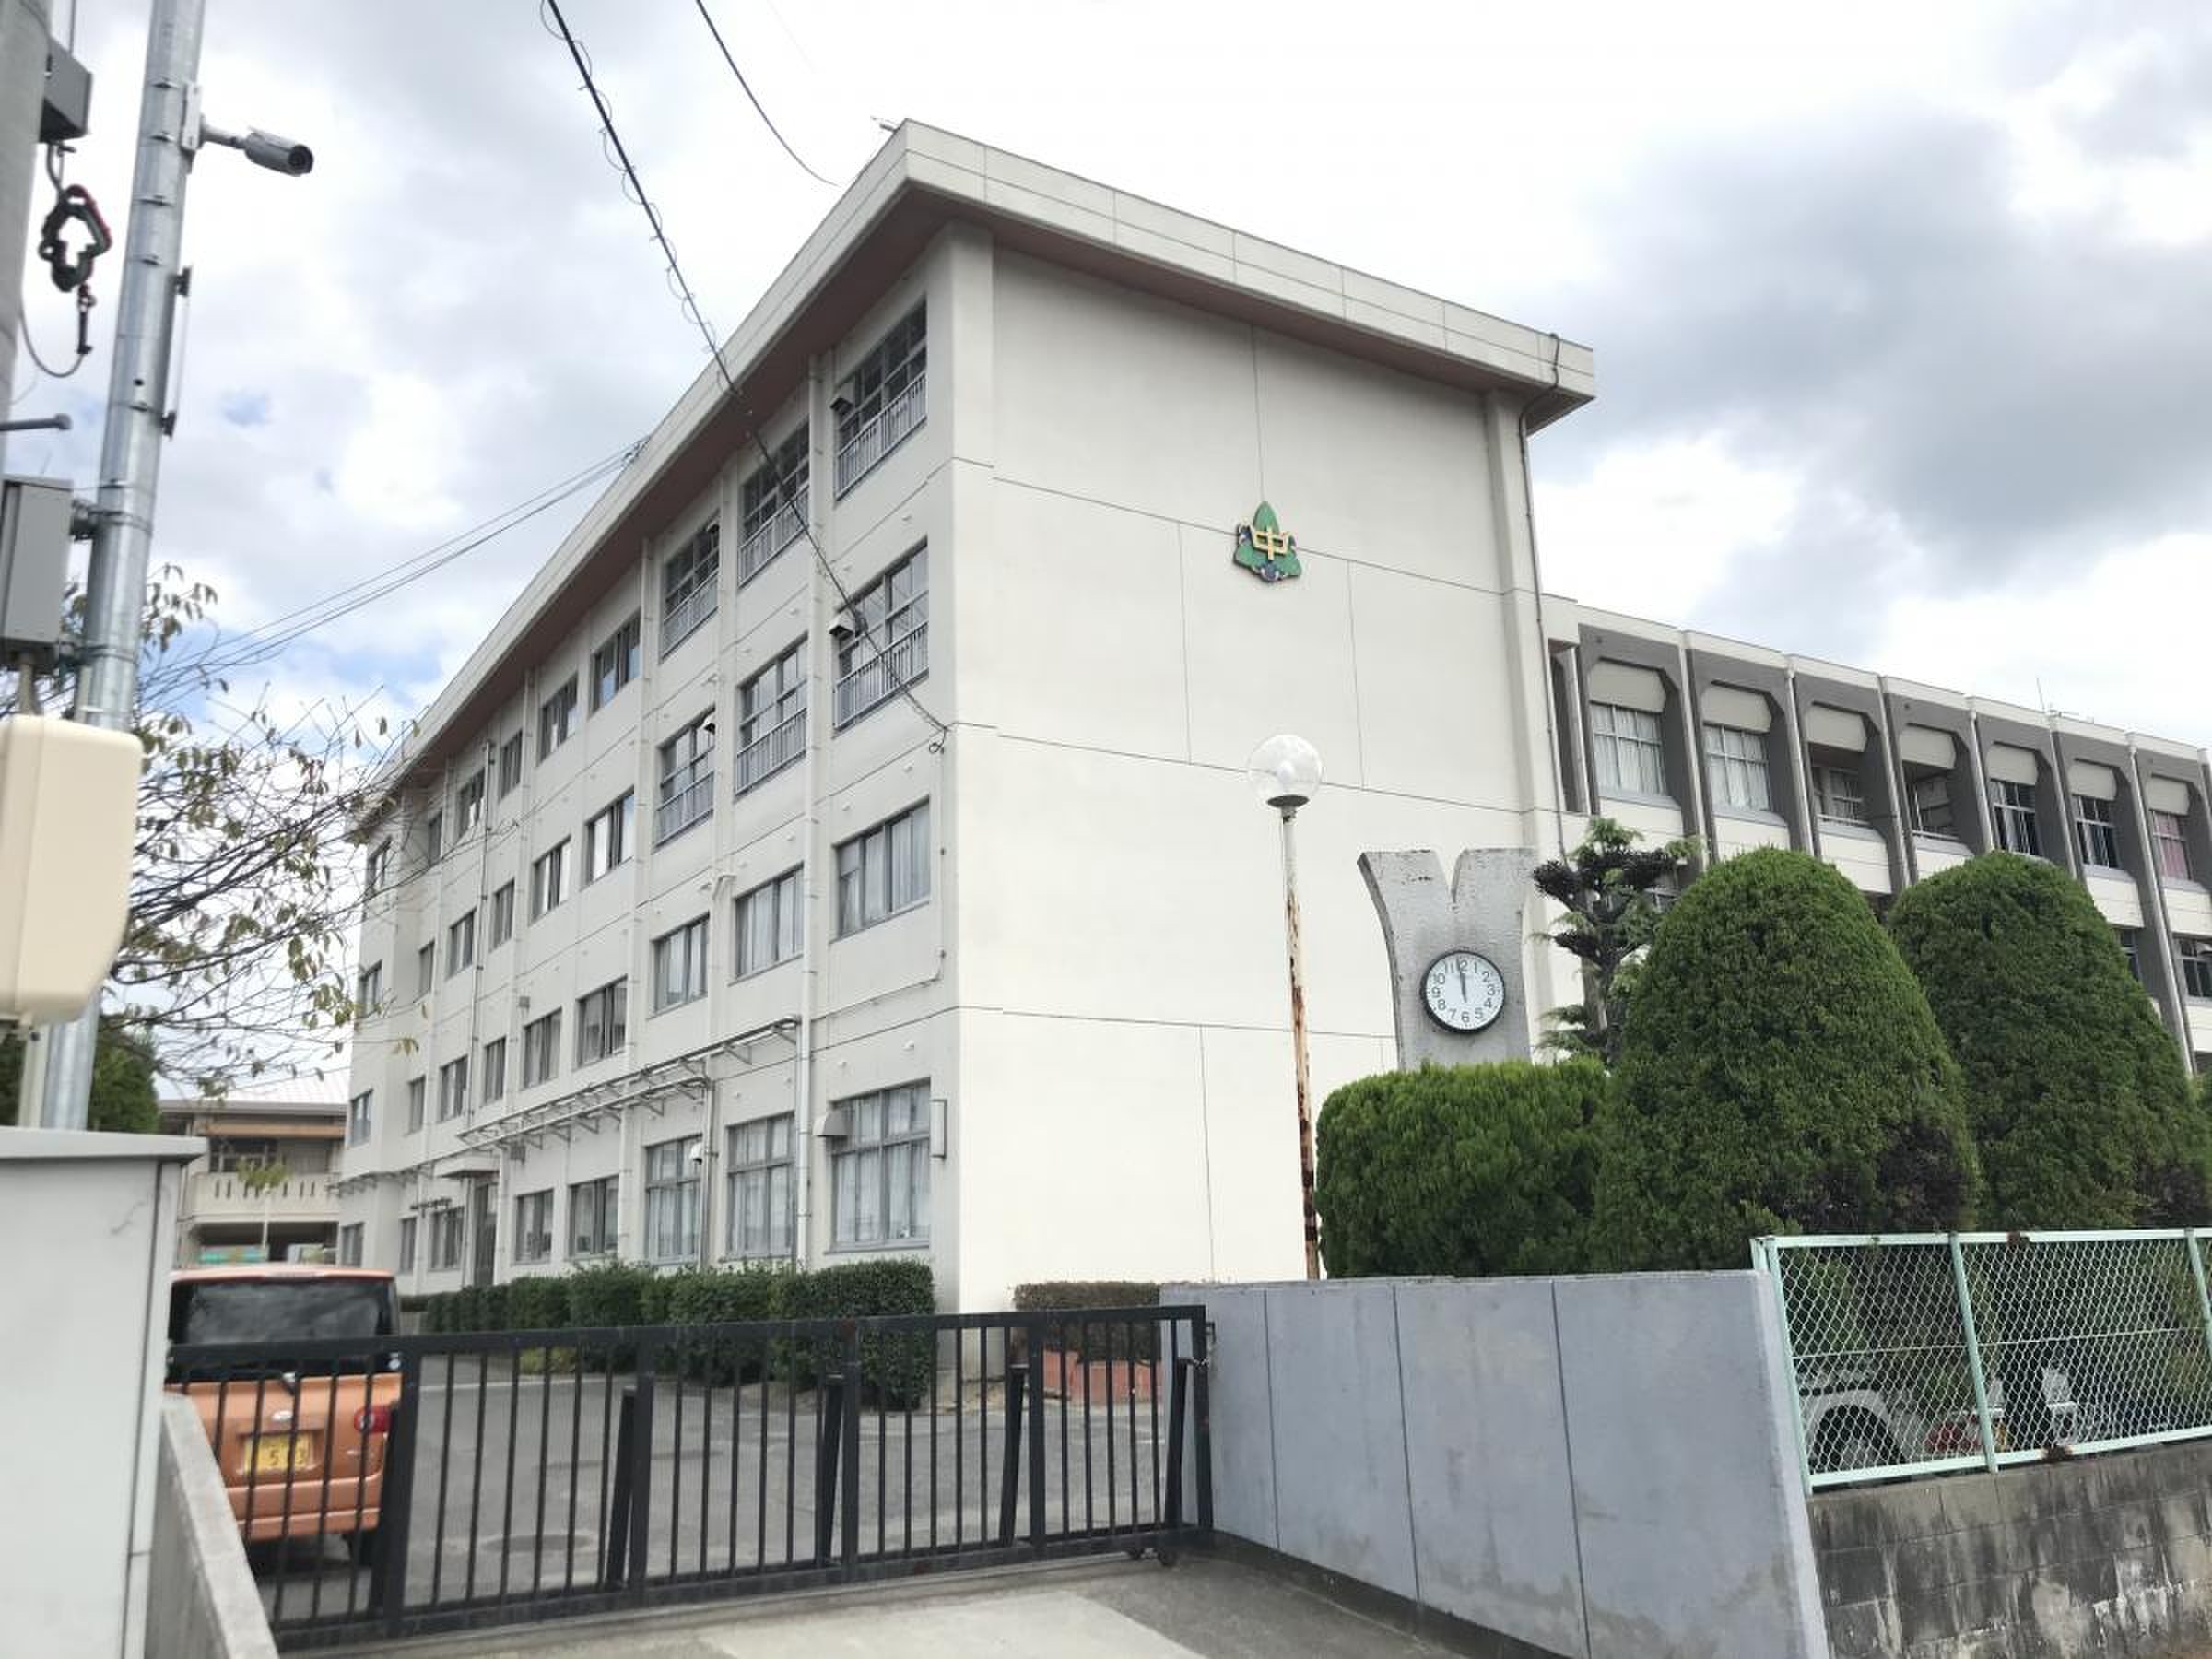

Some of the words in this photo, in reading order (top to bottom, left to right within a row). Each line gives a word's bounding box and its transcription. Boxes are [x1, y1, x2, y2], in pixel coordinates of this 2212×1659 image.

[1253, 527, 1288, 560] 中
[1444, 962, 1454, 973] 11
[1455, 959, 1468, 972] 2
[1433, 973, 1445, 984] 10
[1482, 971, 1490, 982] 2
[1431, 986, 1441, 998] 9
[1488, 984, 1495, 996] 3
[1438, 999, 1446, 1010] 8
[1484, 998, 1491, 1008] 4
[1449, 1008, 1457, 1019] 7
[1461, 1011, 1469, 1022] 6
[1475, 1007, 1483, 1019] 5
